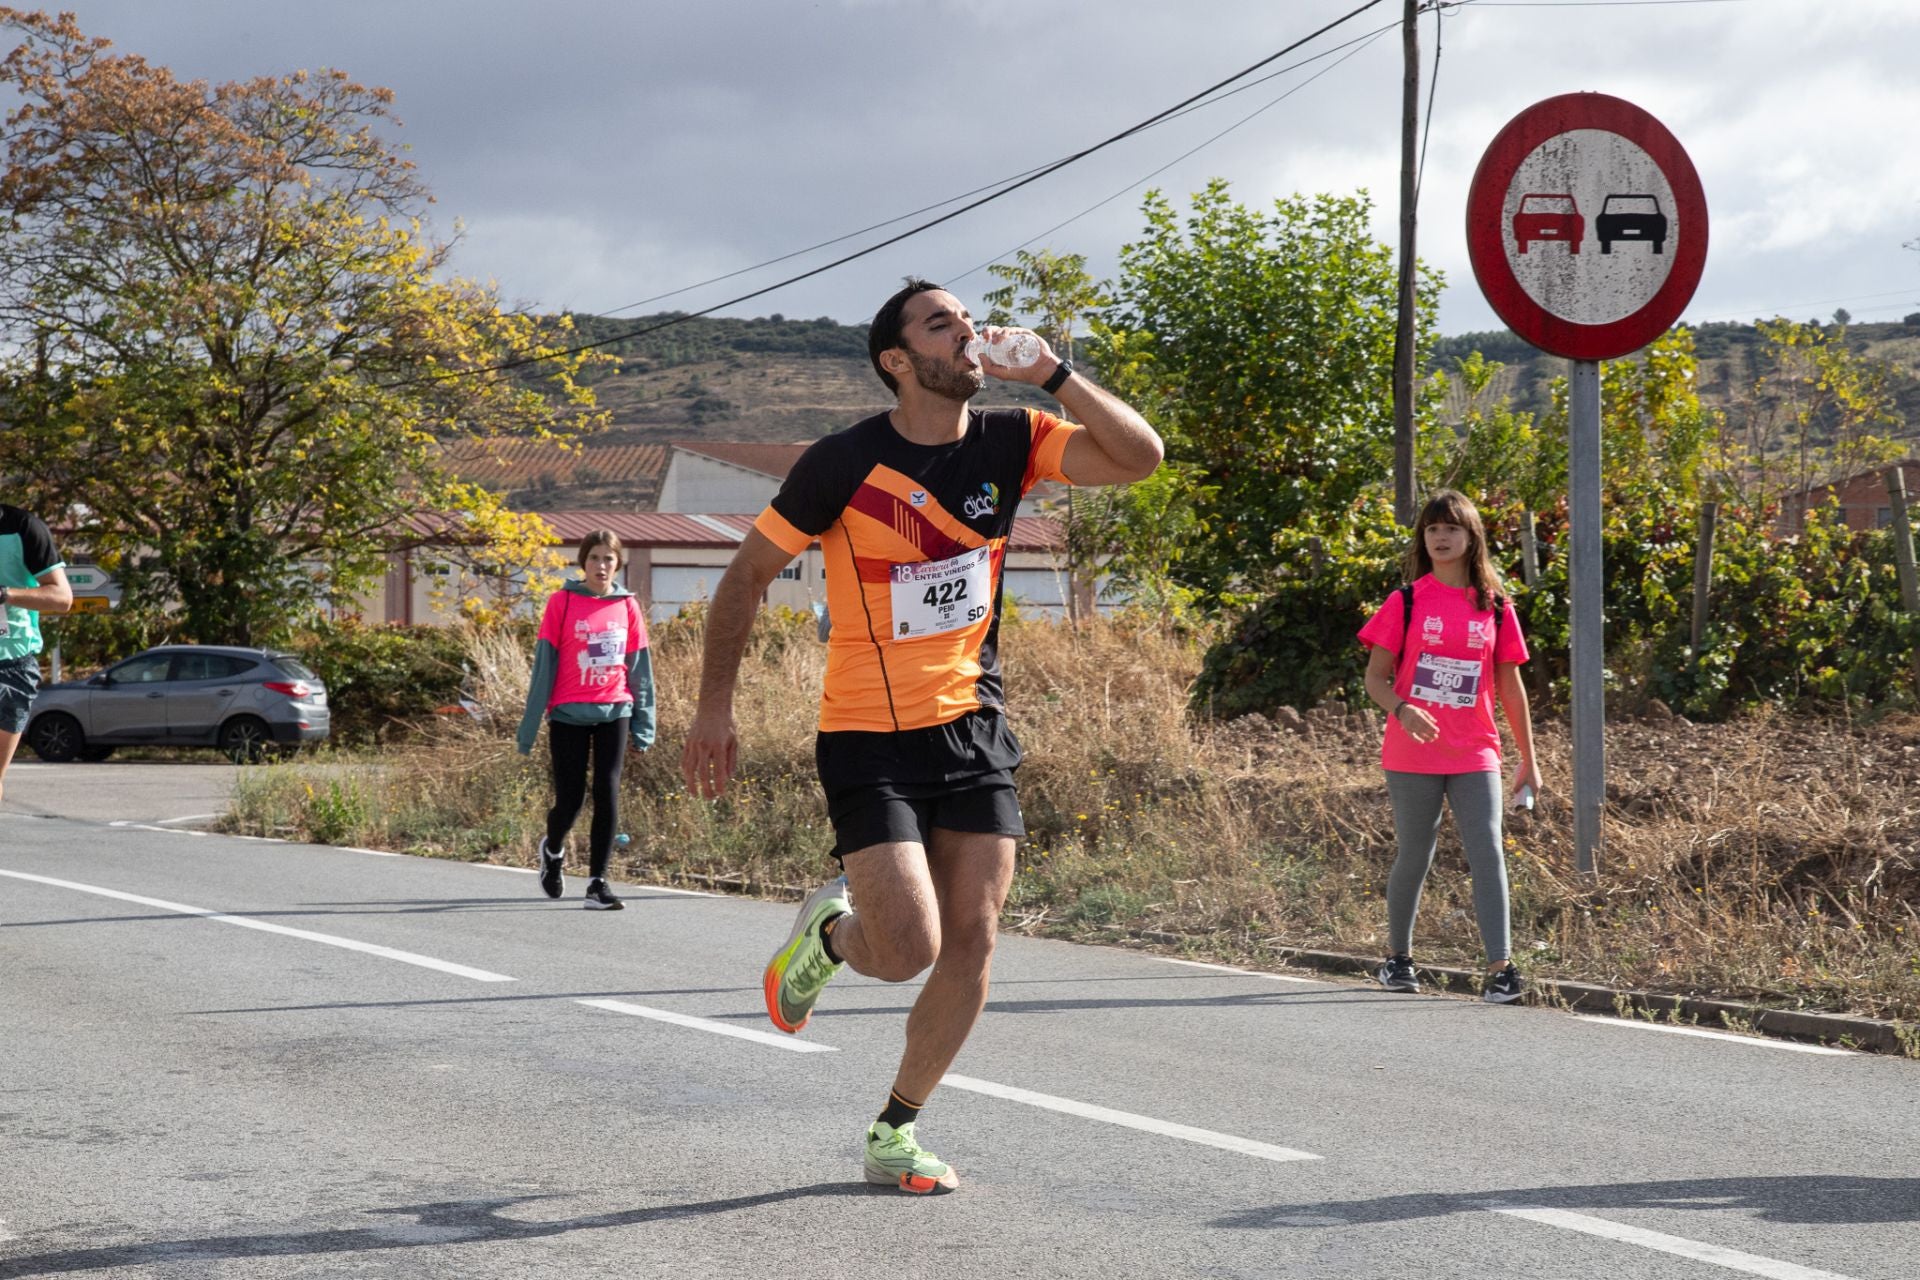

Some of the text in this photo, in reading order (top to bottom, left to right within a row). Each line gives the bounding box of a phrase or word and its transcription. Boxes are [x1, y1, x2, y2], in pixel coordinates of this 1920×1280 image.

[895, 565, 913, 583] 18
[914, 572, 943, 581] ENTRE
[923, 578, 968, 607] 422
[1431, 671, 1463, 689] 960
